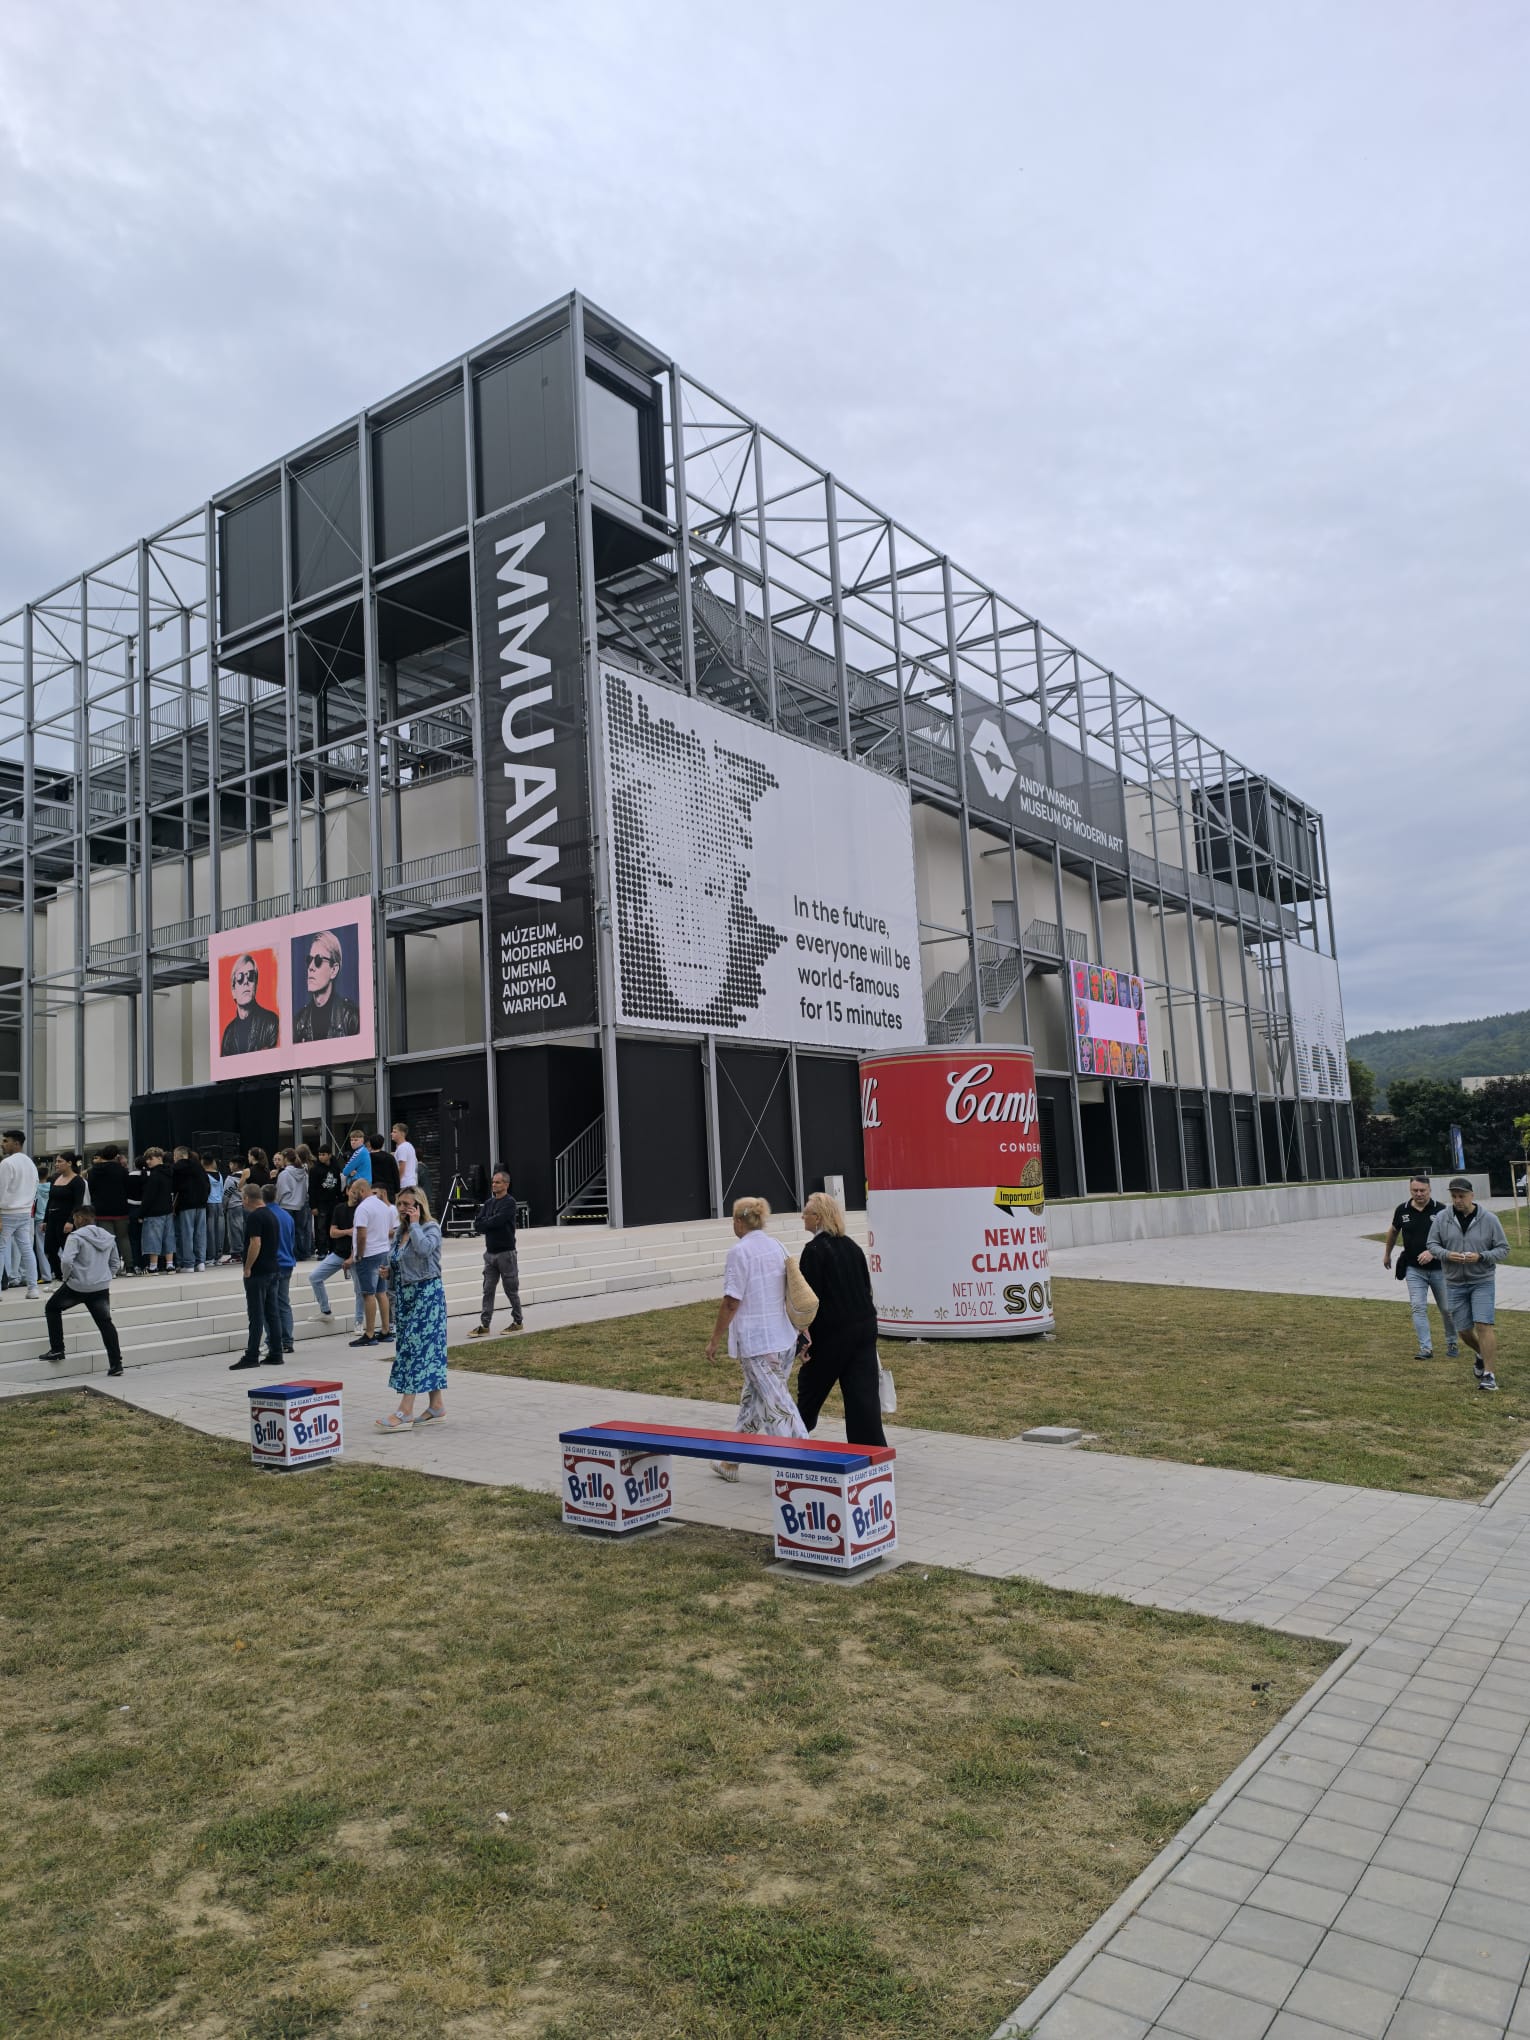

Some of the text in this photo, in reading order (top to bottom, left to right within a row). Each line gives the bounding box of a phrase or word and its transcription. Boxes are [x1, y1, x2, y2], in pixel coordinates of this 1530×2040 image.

[495, 521, 562, 903] MMUAW
[1019, 775, 1082, 818] ANDY WARHOL
[1020, 794, 1124, 854] MUSEUM OF MODERN ART
[793, 894, 890, 939] In the future,
[501, 922, 557, 948] MÚZEUM
[501, 933, 584, 964] MODERNÉHO
[796, 933, 911, 971] everyone will be
[502, 959, 552, 981] UMENIA
[797, 967, 901, 999] world-famous
[502, 976, 556, 998] ANDYHO
[502, 991, 568, 1016] WARHOLA
[800, 996, 903, 1031] for 15 minutes
[984, 1227, 1026, 1247] NEW
[971, 1251, 1030, 1273] CLAM
[952, 1281, 996, 1297] NET WT.
[980, 1300, 997, 1317] OZ.
[254, 1420, 285, 1445] Brillo
[293, 1413, 339, 1446] Brillo
[568, 1473, 614, 1502] Brillo
[624, 1465, 669, 1505] Brillo
[785, 1471, 804, 1480] GIANT
[805, 1473, 818, 1482] SIZE
[781, 1502, 841, 1534] Brillo
[852, 1492, 893, 1538] Brillo
[801, 1532, 816, 1540] soap
[817, 1534, 833, 1542] pads
